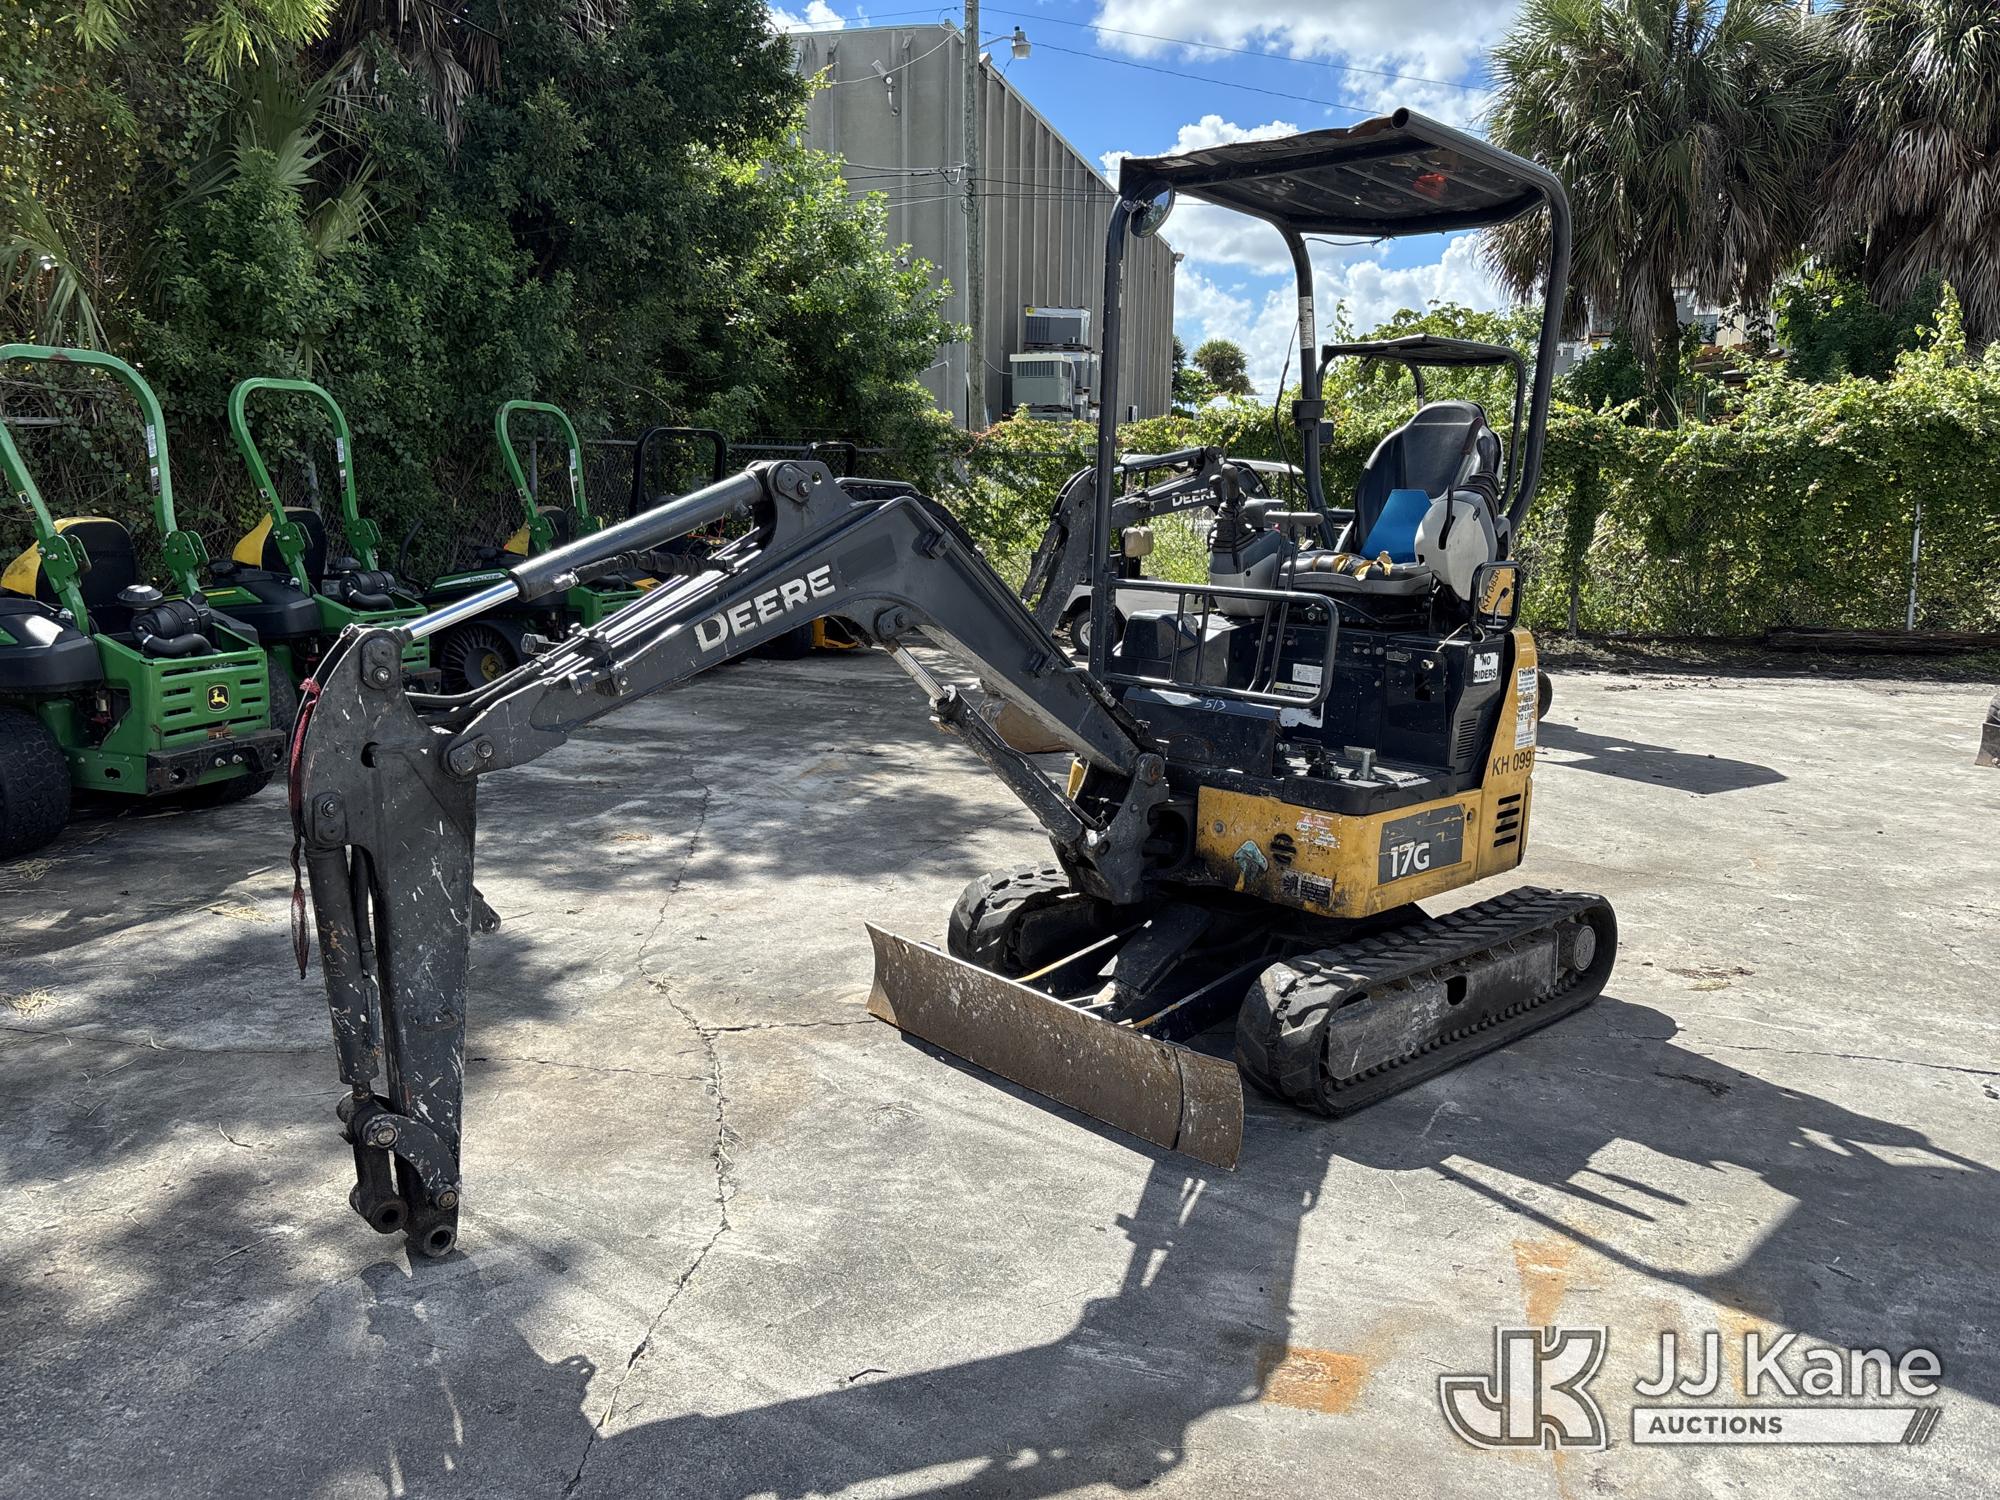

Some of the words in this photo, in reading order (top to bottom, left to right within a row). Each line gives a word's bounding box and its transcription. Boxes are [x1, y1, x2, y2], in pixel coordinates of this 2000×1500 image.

[694, 564, 836, 652] DEERE
[1473, 668, 1497, 680] RIDERS
[1481, 655, 1491, 666] NO
[1491, 754, 1510, 777] KH
[1512, 749, 1535, 772] 099
[1390, 841, 1430, 878] 17G
